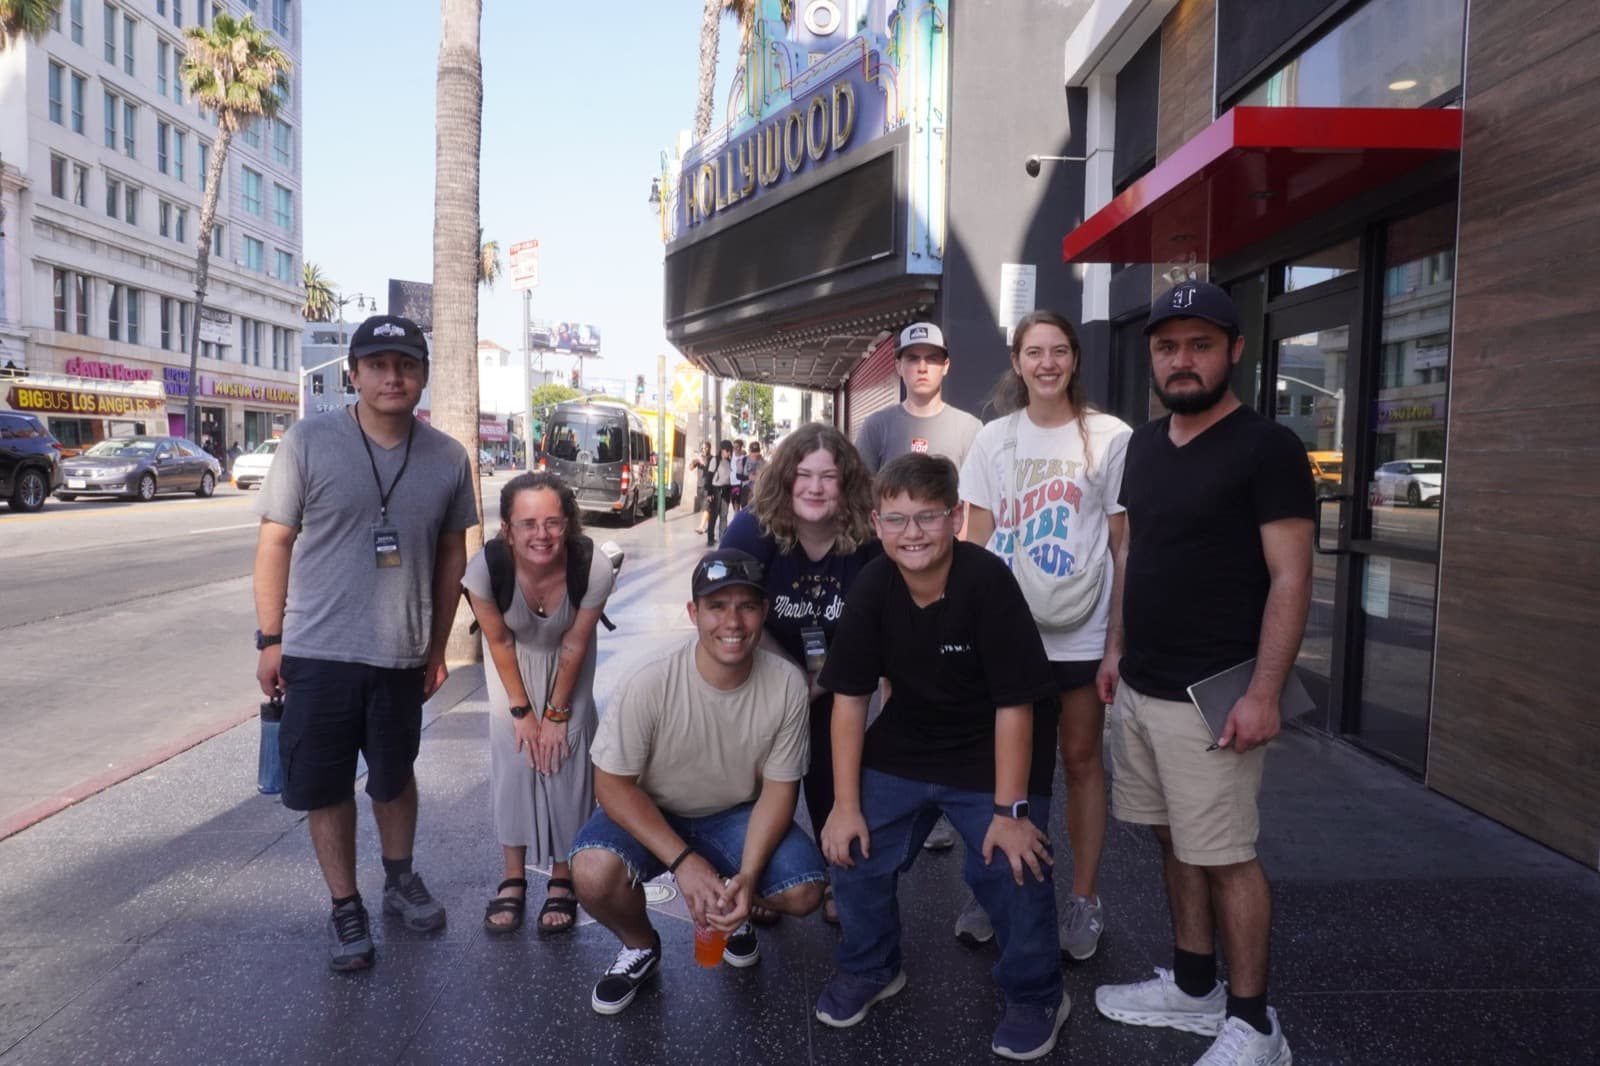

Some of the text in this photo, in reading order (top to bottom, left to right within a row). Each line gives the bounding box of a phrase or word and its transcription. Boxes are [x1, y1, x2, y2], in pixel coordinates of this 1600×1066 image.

[684, 81, 855, 227] HOLLYWOOD
[71, 393, 96, 411] LOS
[97, 396, 153, 414] ANGELES
